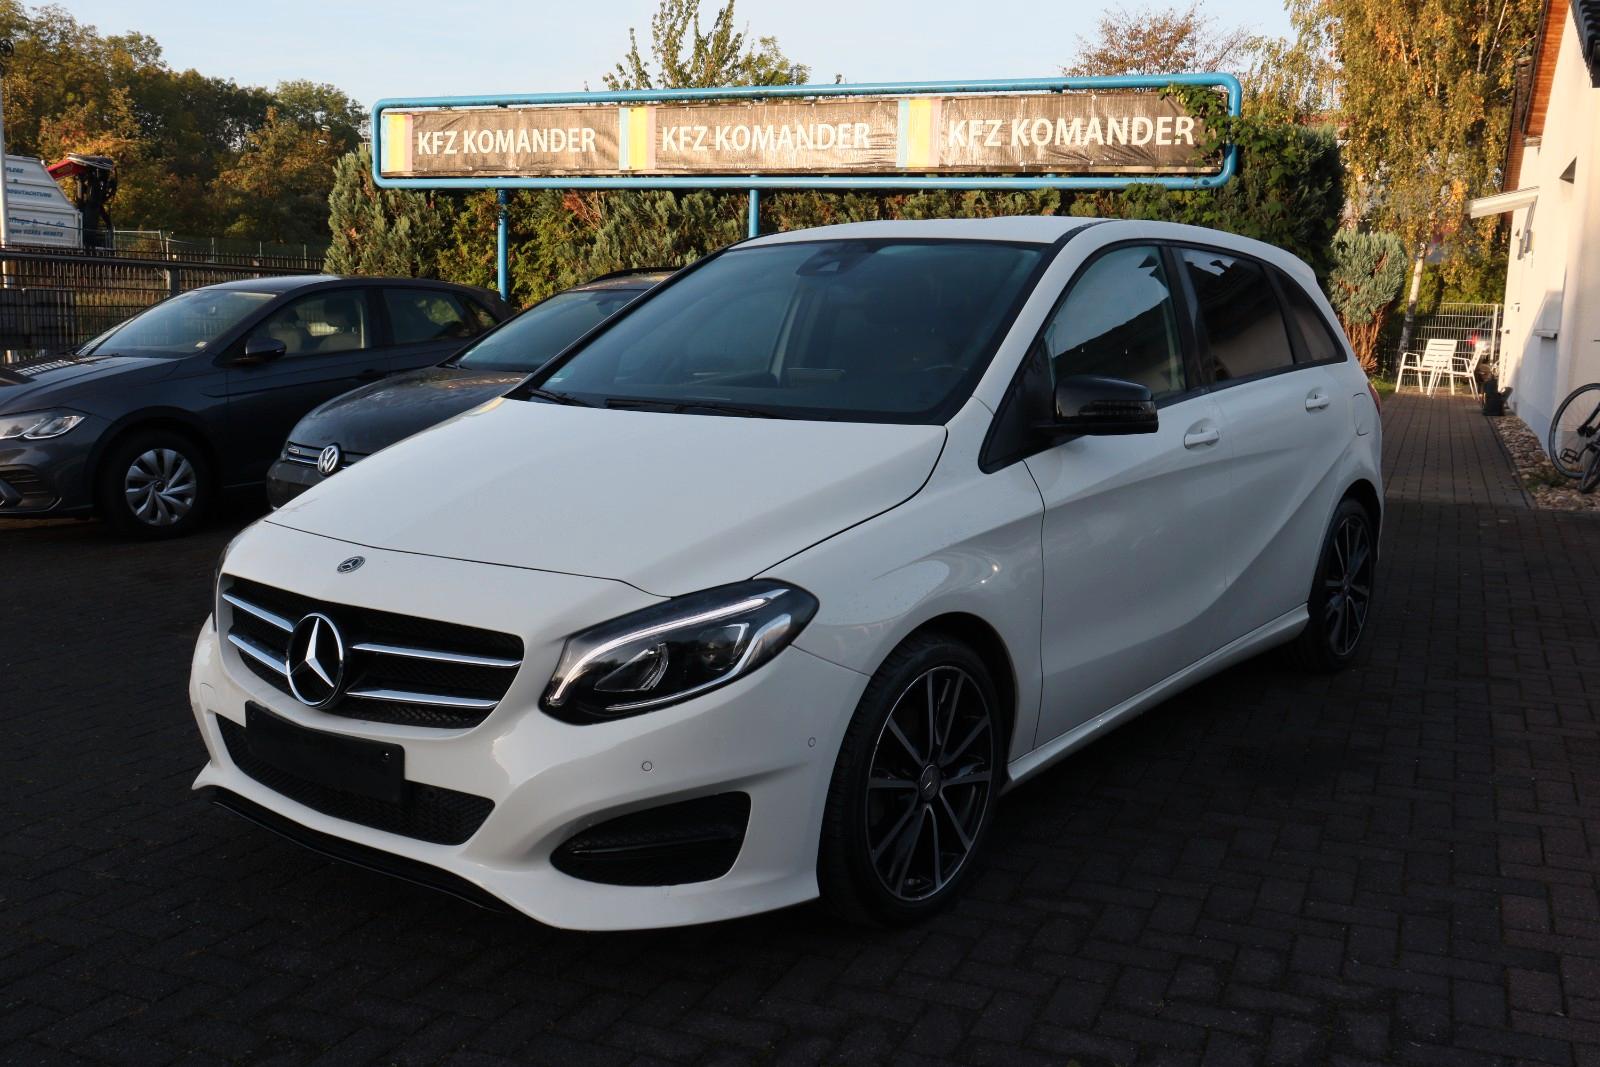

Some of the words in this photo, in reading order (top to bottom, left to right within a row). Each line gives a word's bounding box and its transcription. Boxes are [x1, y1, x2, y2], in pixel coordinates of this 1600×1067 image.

[418, 131, 458, 154] KFZ
[464, 128, 596, 154] KOMANDER
[662, 126, 707, 151] KFZ
[715, 123, 870, 151] KOMANDER
[948, 119, 1002, 147] KFZ
[1011, 117, 1194, 147] KOMANDER
